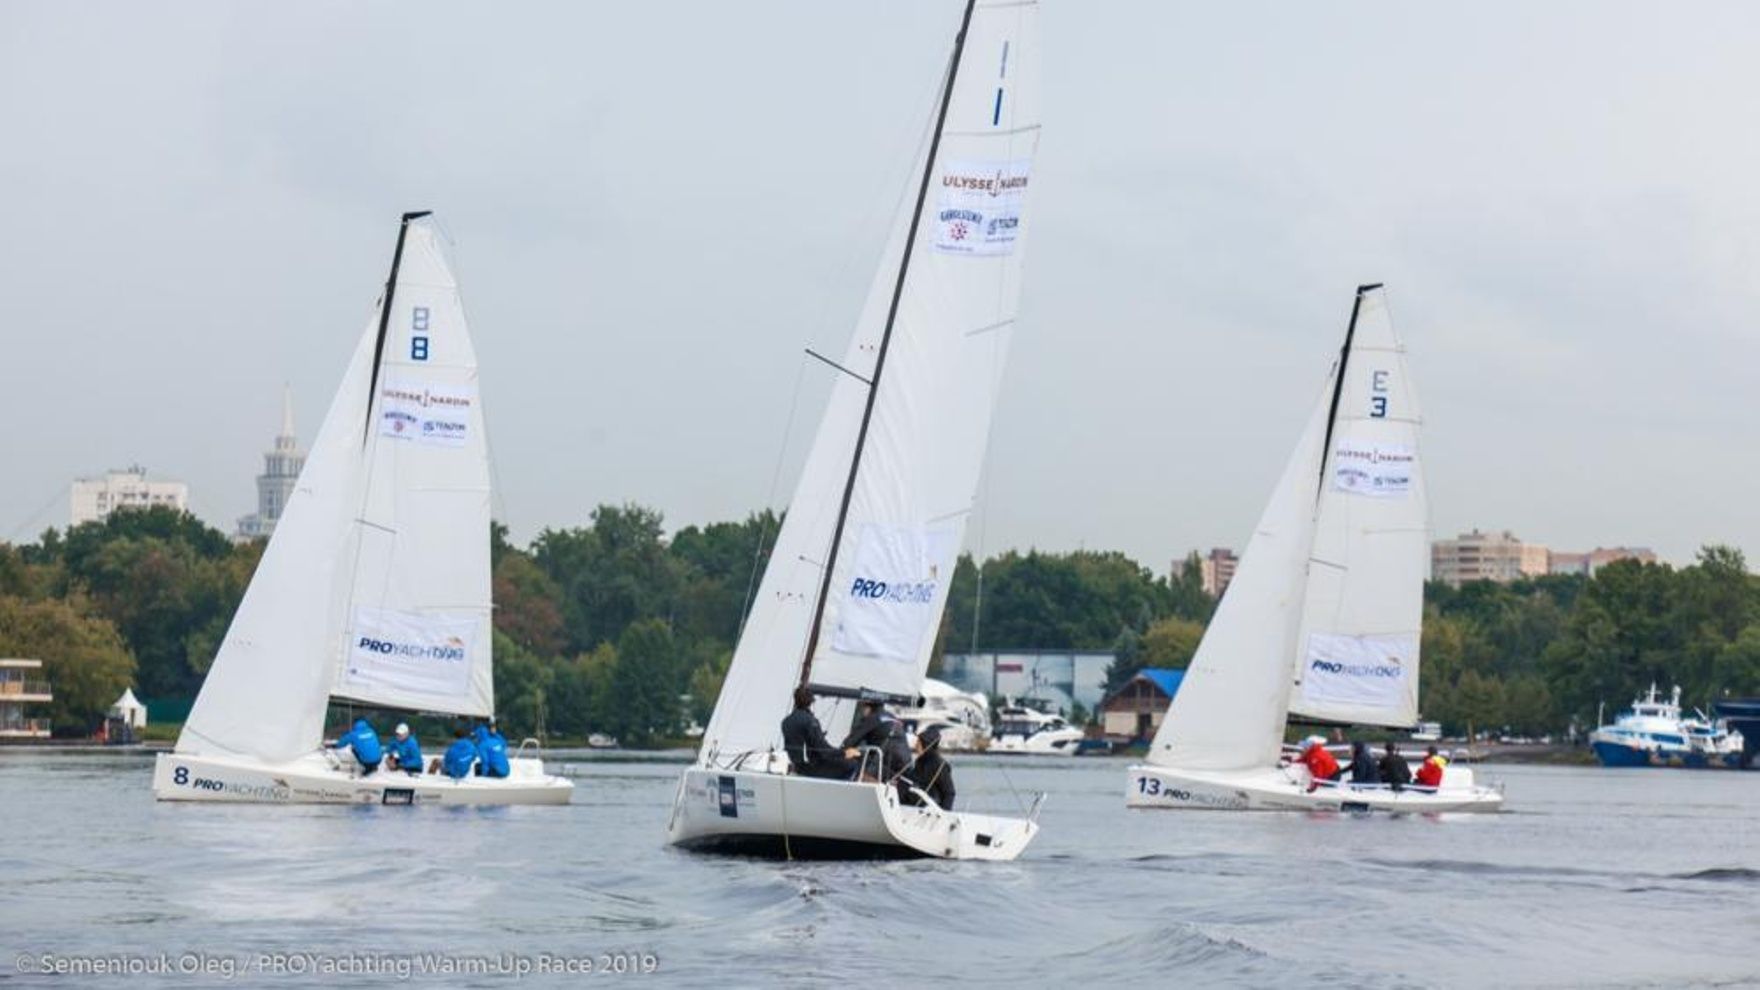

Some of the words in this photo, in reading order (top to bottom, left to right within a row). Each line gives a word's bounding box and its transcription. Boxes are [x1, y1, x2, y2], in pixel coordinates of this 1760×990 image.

[943, 176, 993, 190] ULYSSE
[411, 336, 429, 361] 8
[1370, 396, 1387, 418] 3
[173, 766, 189, 785] 8
[1138, 776, 1161, 795] 13
